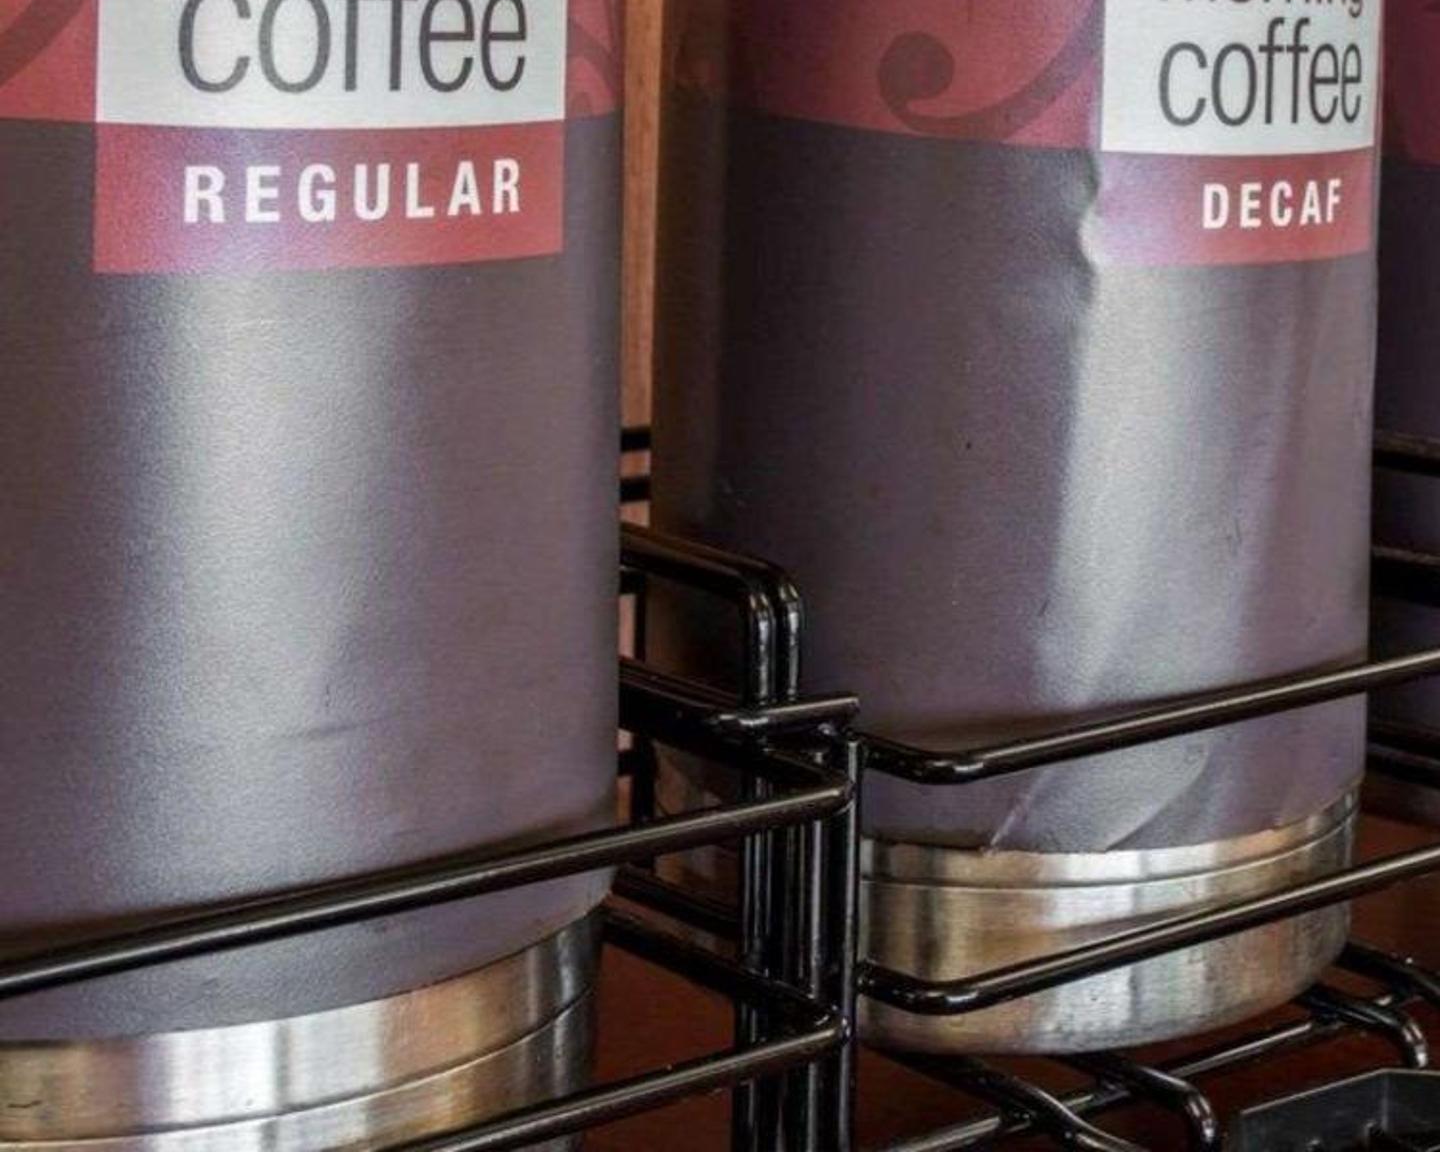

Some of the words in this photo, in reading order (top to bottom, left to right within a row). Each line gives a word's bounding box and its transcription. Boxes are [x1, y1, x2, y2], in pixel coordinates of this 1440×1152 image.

[1158, 17, 1363, 128] coffee
[182, 157, 521, 224] REGULAR
[1202, 178, 1343, 230] DECAF
